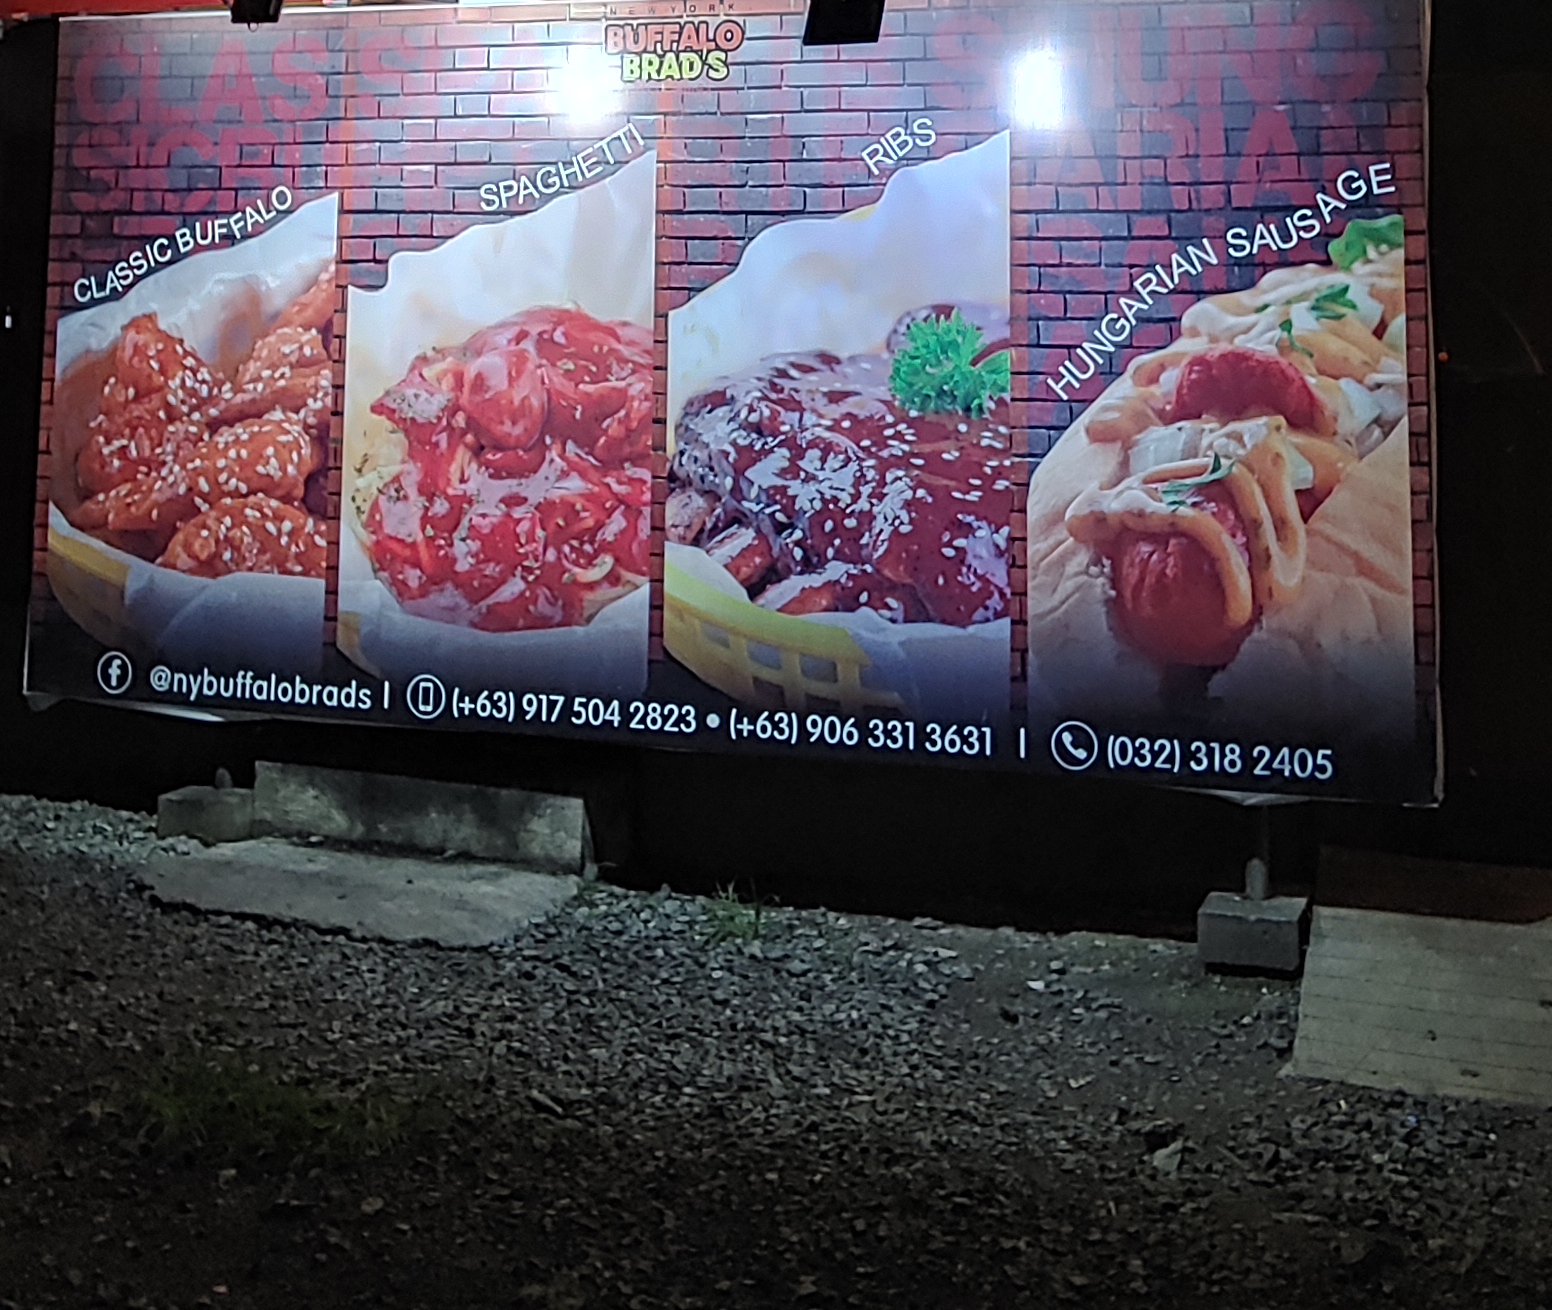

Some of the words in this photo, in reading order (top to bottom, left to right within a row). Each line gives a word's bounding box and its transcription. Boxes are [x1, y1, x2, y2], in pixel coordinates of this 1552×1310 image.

[605, 19, 746, 56] BUFFALO
[621, 49, 730, 83] BRAD'S
[479, 122, 645, 211] SPAGHETTI
[861, 118, 937, 176] RIBS
[73, 237, 172, 303] CLASSIC
[175, 185, 292, 253] BUFFALO
[1046, 237, 1219, 401] HUNGARIAN
[1225, 162, 1396, 259] SAUSAGE
[150, 664, 372, 710] @nybuffalobrads
[452, 692, 515, 723] (+63)
[522, 693, 565, 723] 917
[571, 697, 621, 728] 504
[629, 701, 697, 733] 2823
[729, 707, 798, 745] (+63)
[806, 714, 859, 746] 906
[867, 718, 915, 751] 331
[925, 723, 992, 756] 3631
[1107, 734, 1181, 773] (032)
[1189, 741, 1242, 773] 318
[1252, 745, 1333, 780] 2405
